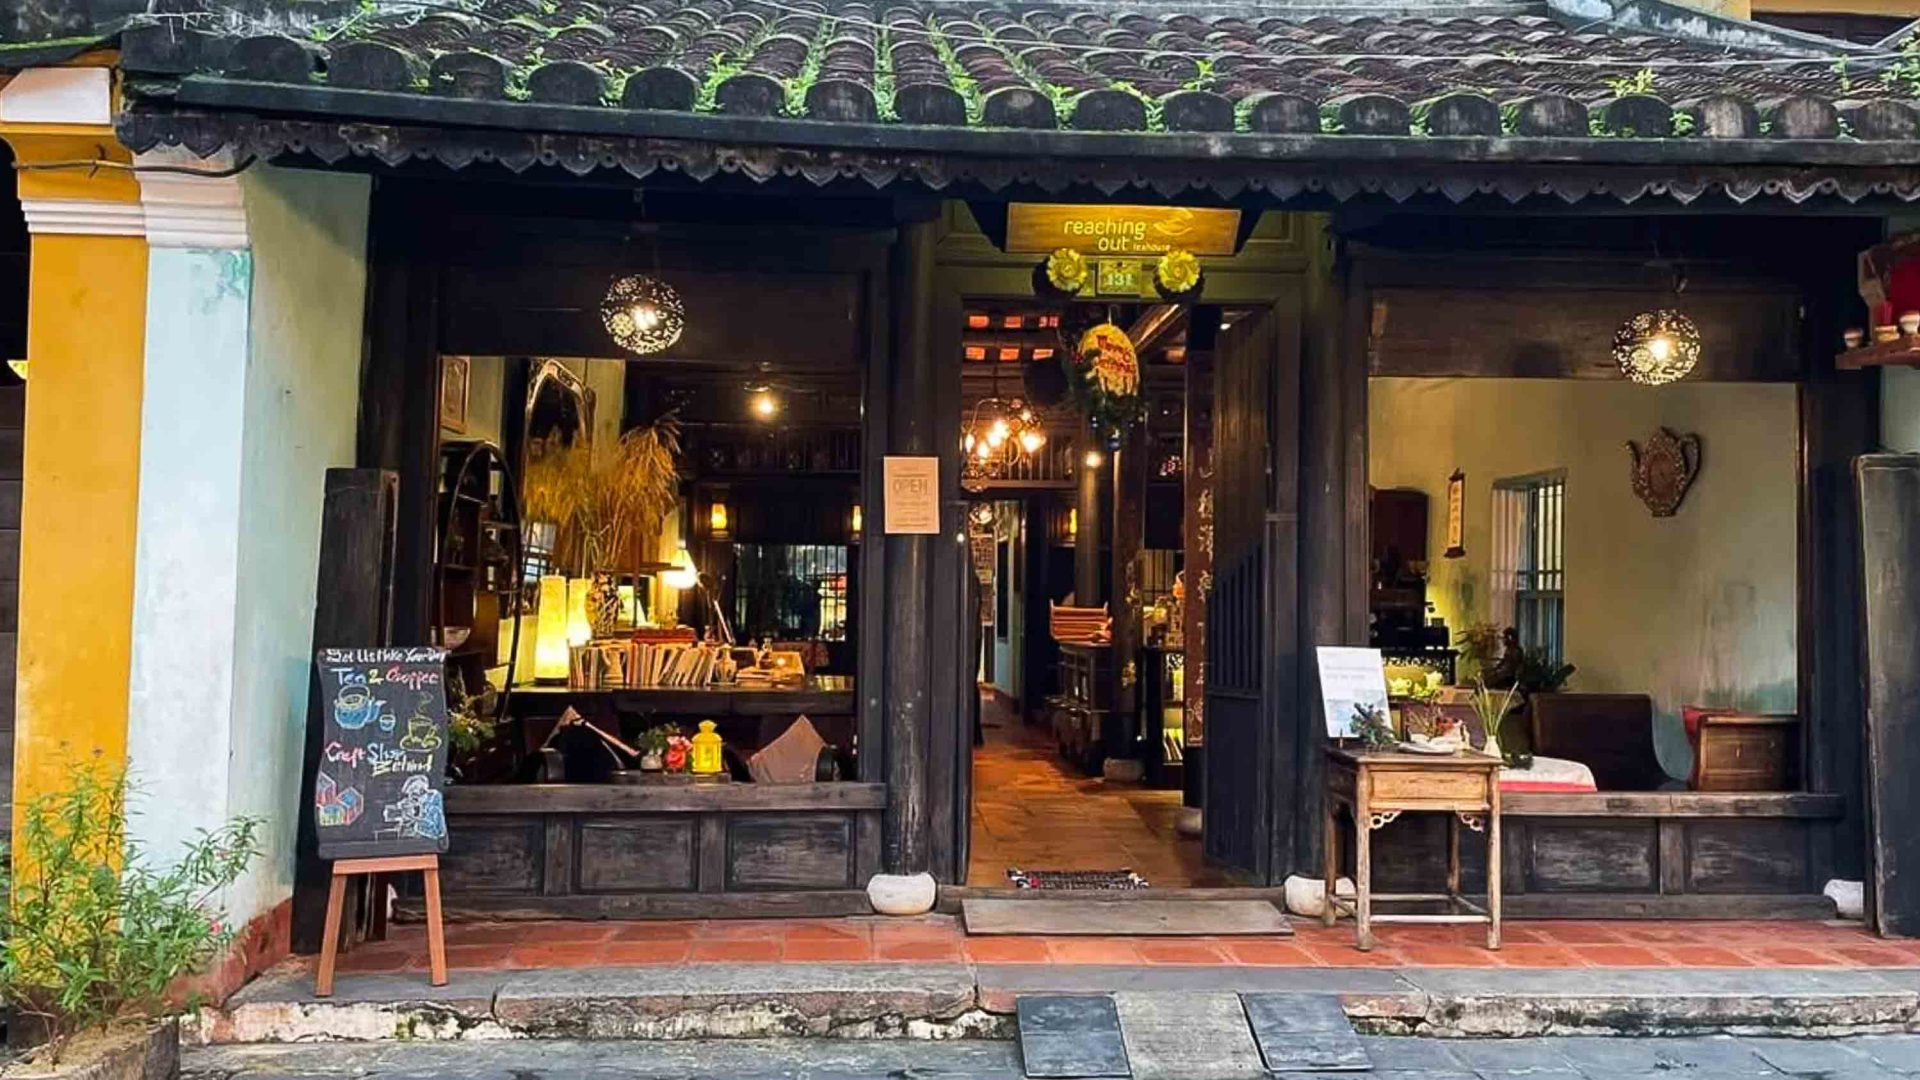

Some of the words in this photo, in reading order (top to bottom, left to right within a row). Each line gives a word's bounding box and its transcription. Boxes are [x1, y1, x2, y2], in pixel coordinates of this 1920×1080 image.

[1063, 217, 1146, 240] reaching
[1098, 236, 1130, 252] out
[1106, 273, 1133, 286] 131
[892, 479, 928, 495] OPEN
[330, 667, 367, 685] Tea
[325, 741, 366, 769] Craft
